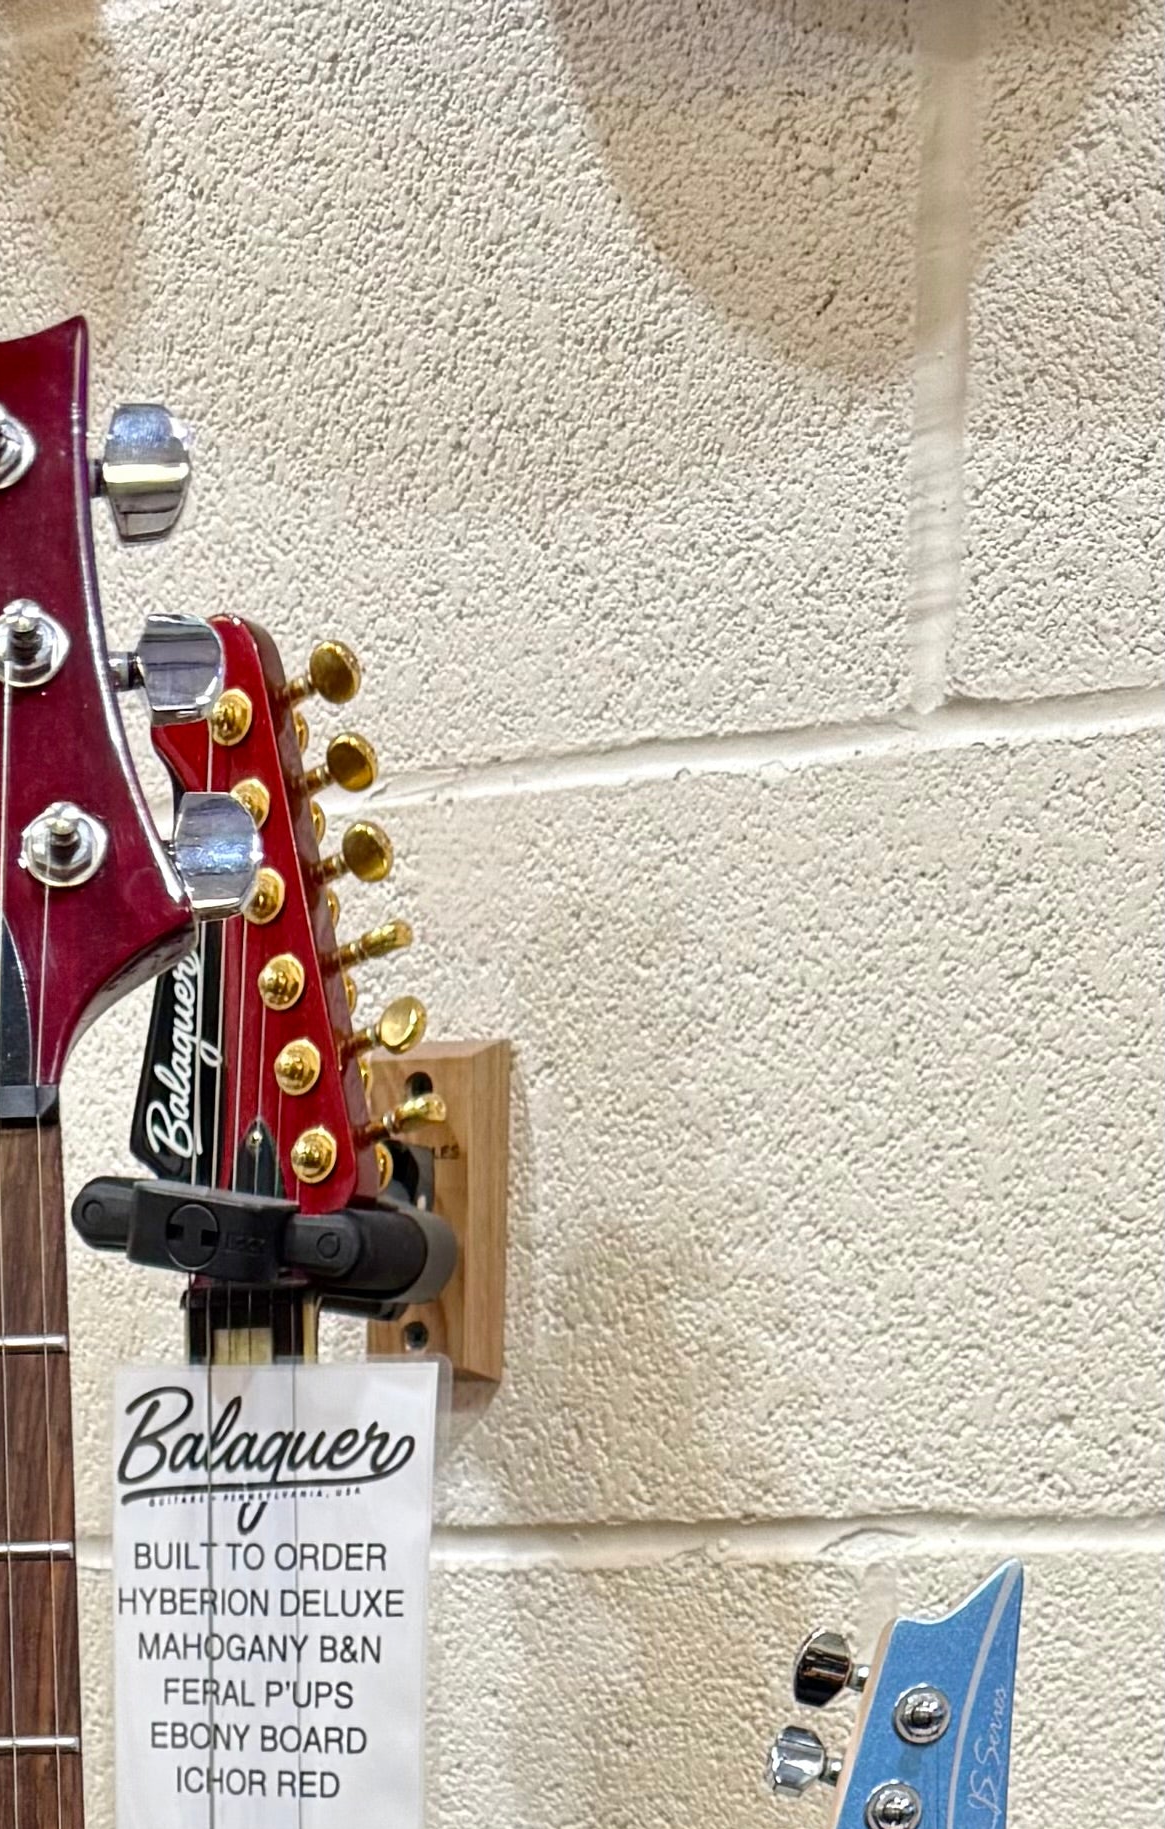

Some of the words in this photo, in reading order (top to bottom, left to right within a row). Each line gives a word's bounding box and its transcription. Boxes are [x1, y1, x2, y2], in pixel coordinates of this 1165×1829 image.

[117, 1385, 417, 1536] Balaguer
[134, 1542, 218, 1570] BUILT
[225, 1542, 266, 1571] TO
[274, 1543, 387, 1572] ORDER
[118, 1587, 270, 1617] HYBERION
[279, 1589, 405, 1618] DELUXE
[138, 1632, 309, 1663] MAHOGANY
[319, 1635, 382, 1664] B&N
[163, 1678, 256, 1708] FERAL
[150, 1722, 251, 1751] EBONY
[260, 1725, 368, 1755] BOARD
[175, 1766, 267, 1797] ICHOR
[277, 1770, 341, 1799] RED
